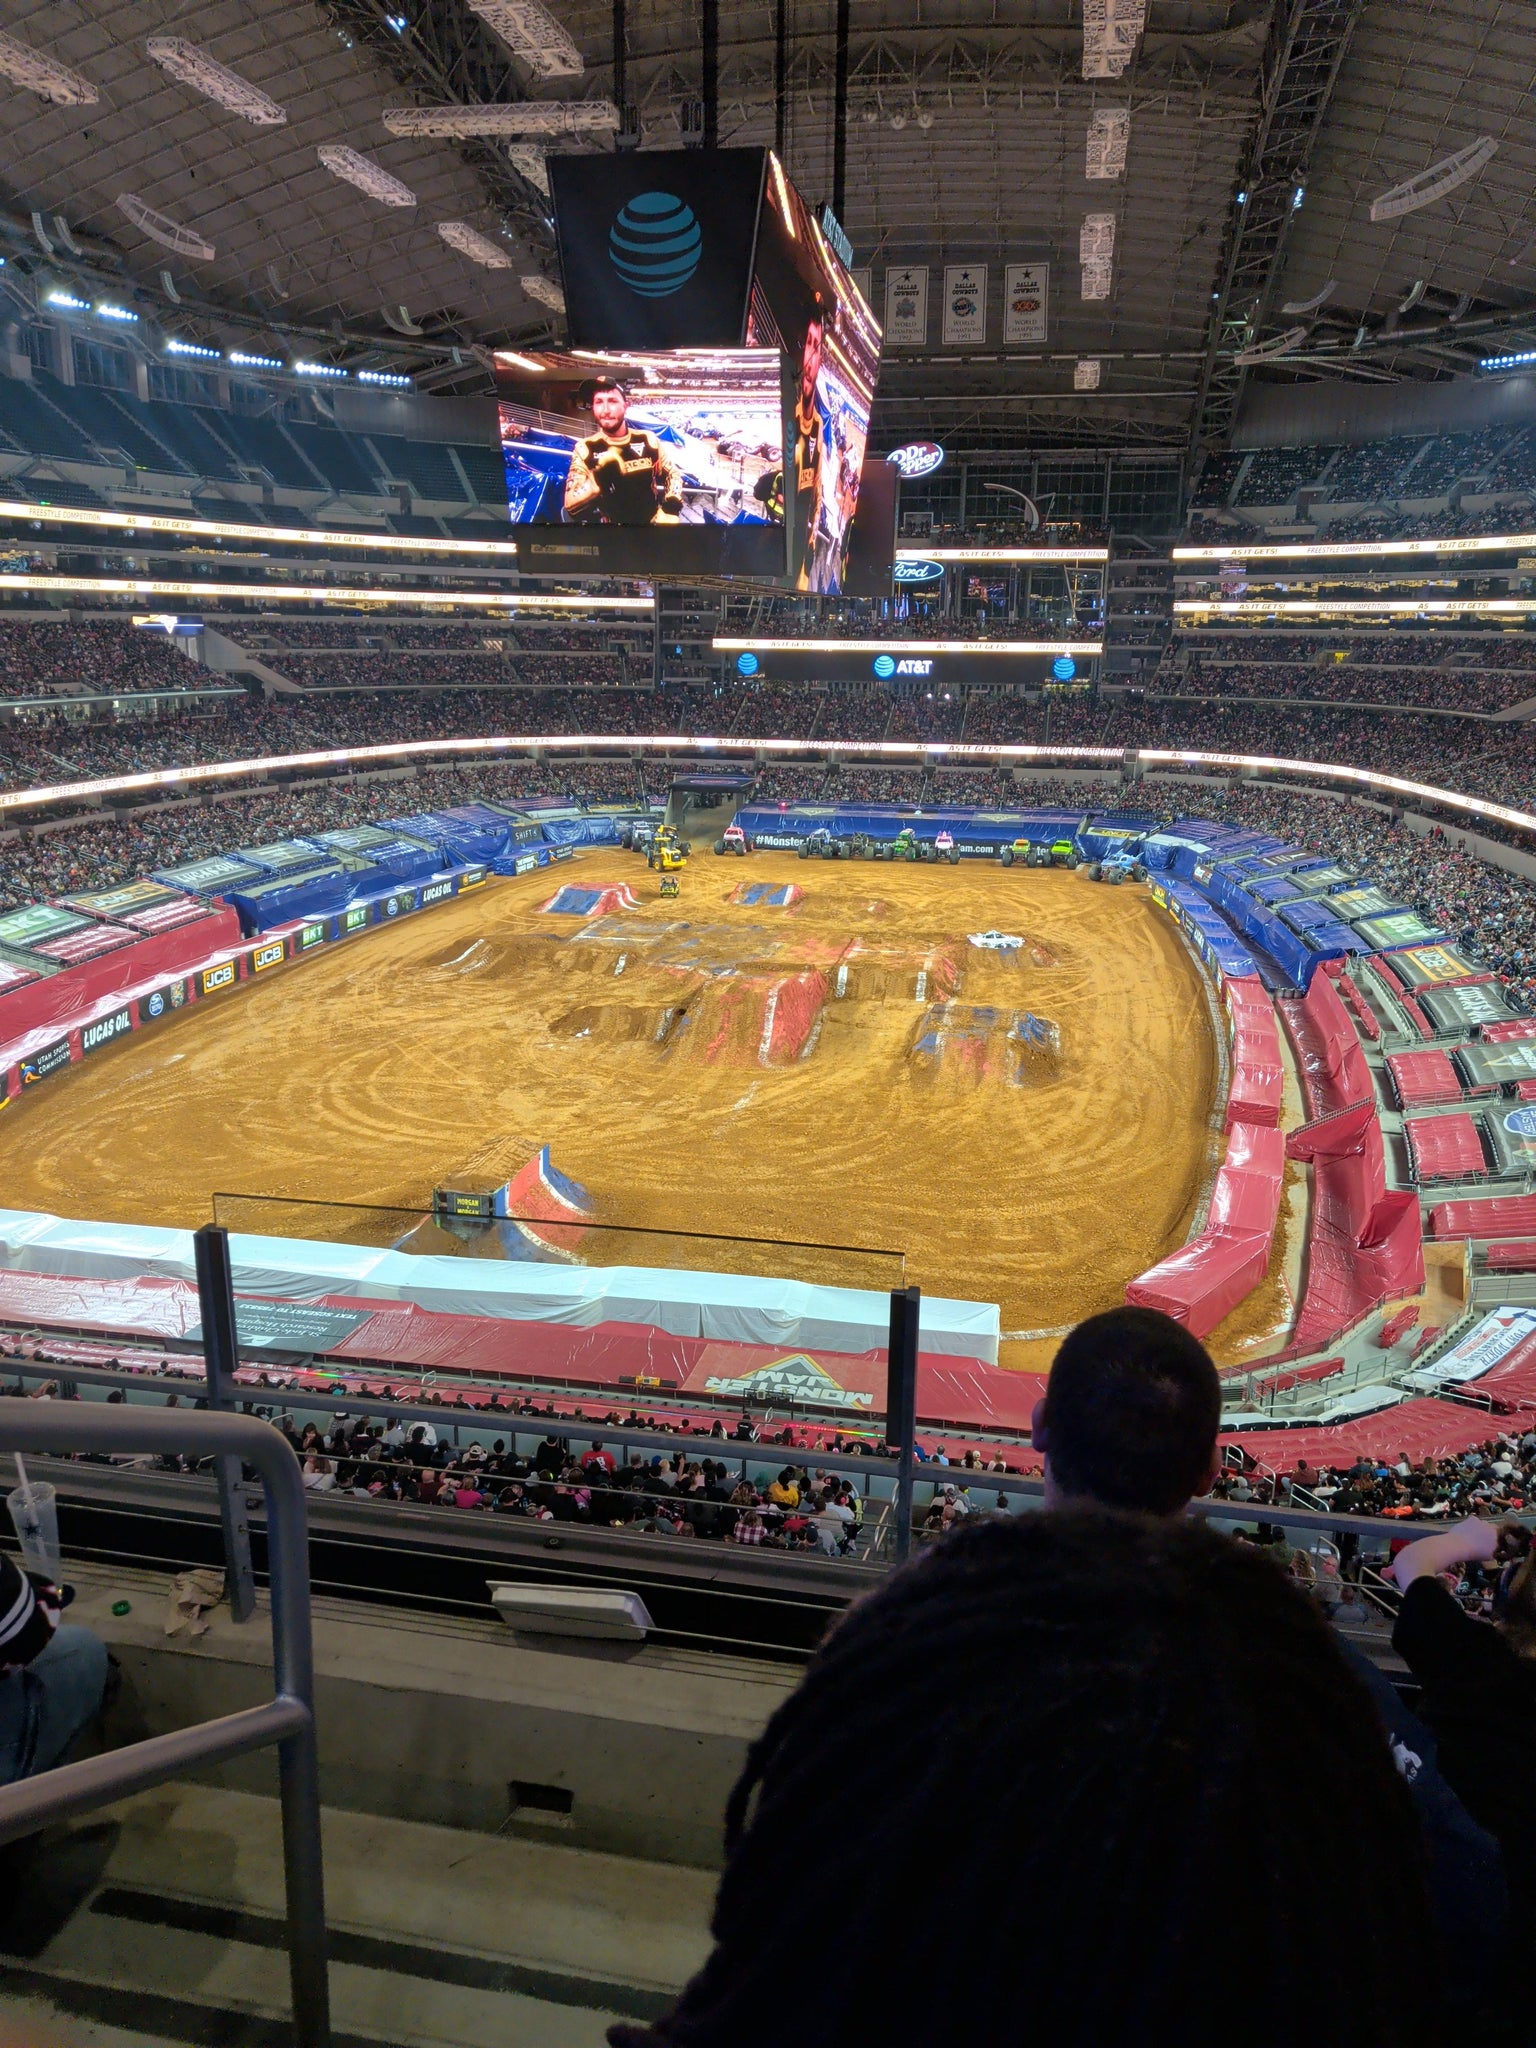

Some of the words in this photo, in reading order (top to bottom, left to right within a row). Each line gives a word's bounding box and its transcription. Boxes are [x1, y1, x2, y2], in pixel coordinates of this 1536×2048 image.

[907, 445, 927, 459] Dr
[1307, 546, 1340, 554] FREESTYLE
[1341, 544, 1382, 553] COMPETITION
[1458, 540, 1480, 548] GETS!
[894, 560, 929, 578] Ford
[1418, 602, 1429, 610] AS
[1446, 602, 1457, 610] AS
[1467, 602, 1490, 610] GETS!
[896, 659, 933, 674] AT&T
[423, 884, 443, 902] LUCAS
[347, 910, 366, 927] BKT
[303, 925, 323, 941] BKT
[257, 946, 281, 966] JCB
[206, 967, 232, 988] JCB
[84, 1017, 115, 1049] LUCAS
[115, 1010, 131, 1031] OIL
[37, 1052, 52, 1065] UTAH
[38, 1050, 71, 1074] COMMISSION
[1505, 1329, 1528, 1346] FORT
[1480, 1342, 1510, 1366] WORTH
[755, 1369, 833, 1388] JAM
[704, 1376, 874, 1405] MONSTER
